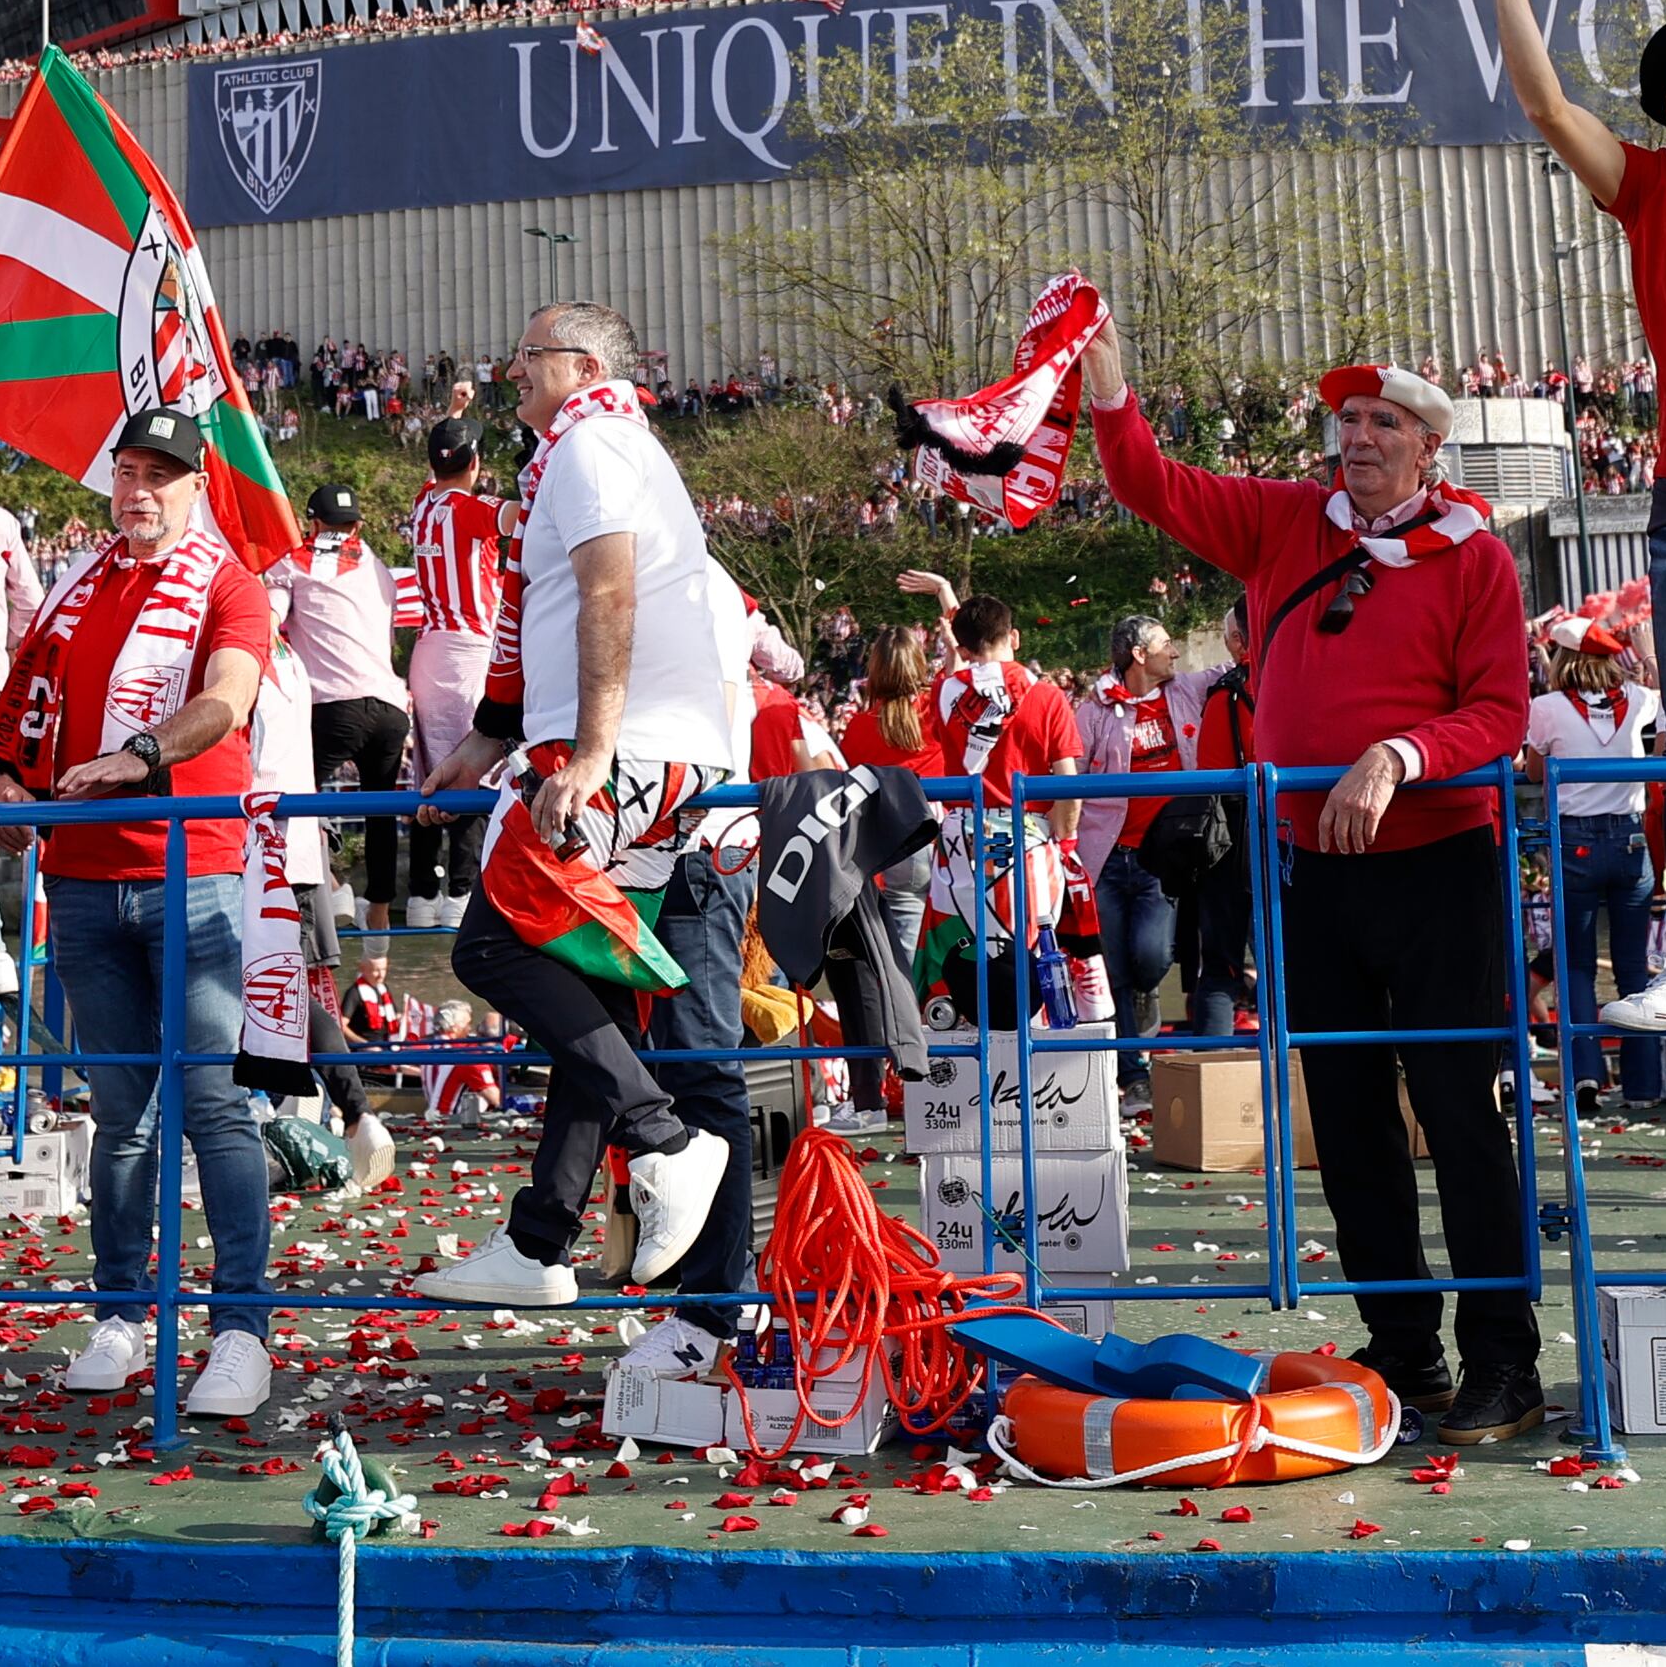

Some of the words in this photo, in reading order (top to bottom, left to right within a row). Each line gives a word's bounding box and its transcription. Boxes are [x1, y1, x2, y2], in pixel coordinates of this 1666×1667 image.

[222, 70, 279, 87] ATHLETIC
[281, 65, 315, 81] CLUB
[508, 4, 951, 172] UNIQUE
[246, 165, 292, 206] BILBAO
[19, 675, 59, 740] 25
[766, 764, 880, 904] DIGI
[967, 1051, 1091, 1111] alzla
[924, 1100, 961, 1119] 24u
[924, 1118, 961, 1130] 330ml
[936, 1221, 973, 1239] 24u
[936, 1238, 974, 1250] 330ml
